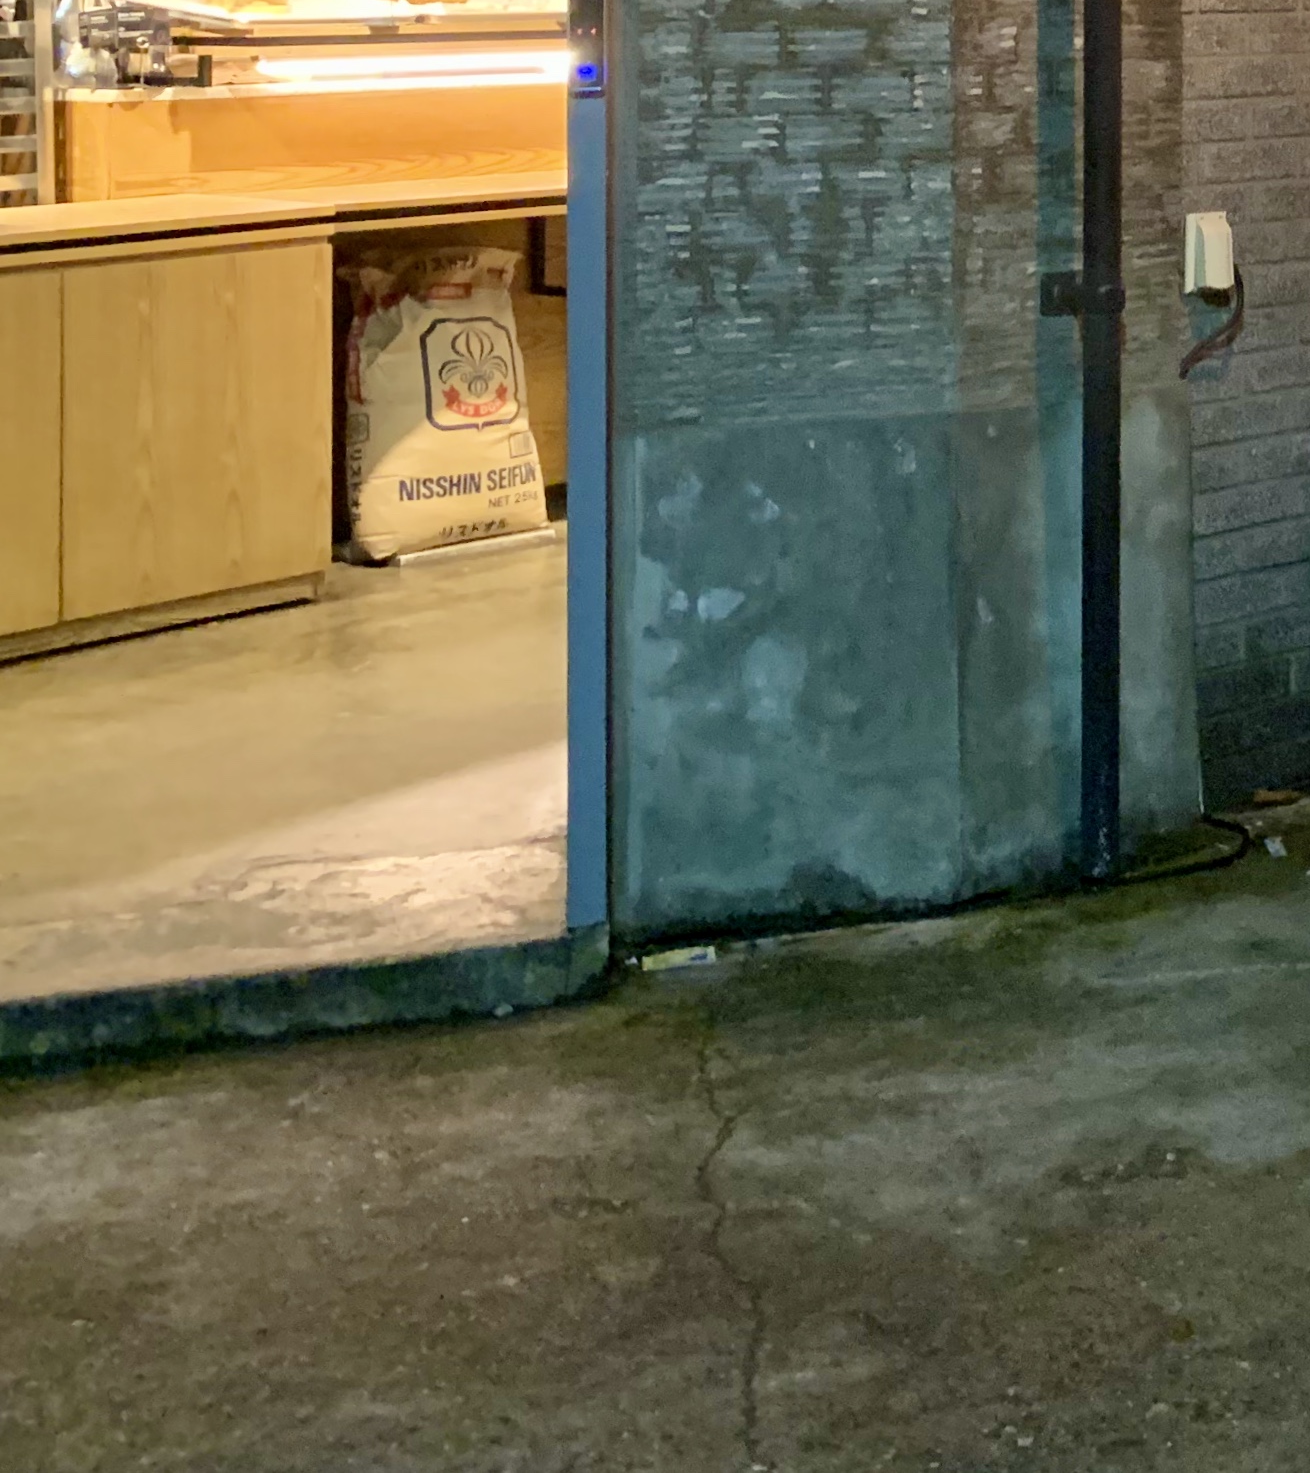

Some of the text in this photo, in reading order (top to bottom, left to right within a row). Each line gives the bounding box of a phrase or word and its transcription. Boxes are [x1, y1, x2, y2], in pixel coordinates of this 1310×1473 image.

[399, 461, 537, 502] NISSHIN SEIFUN
[488, 494, 511, 509] NET
